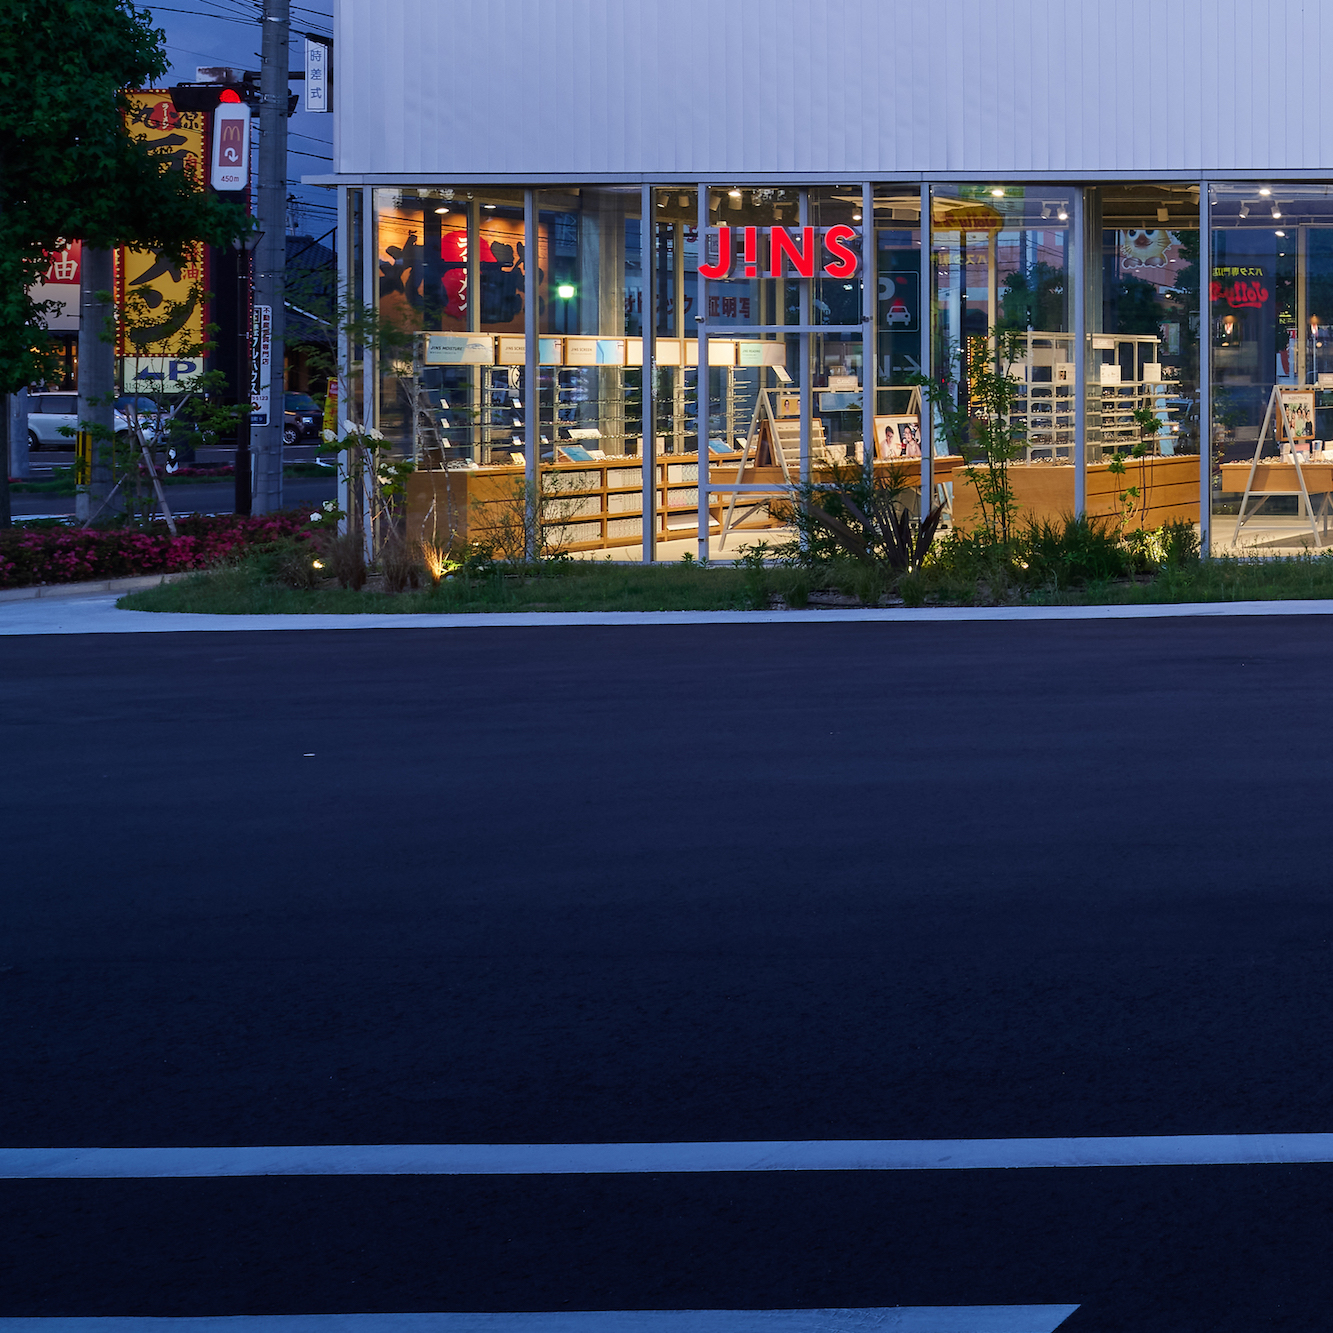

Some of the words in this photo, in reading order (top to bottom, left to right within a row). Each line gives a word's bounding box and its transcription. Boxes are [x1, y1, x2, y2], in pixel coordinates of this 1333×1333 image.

[310, 49, 322, 99] 時差式
[169, 361, 197, 381] P
